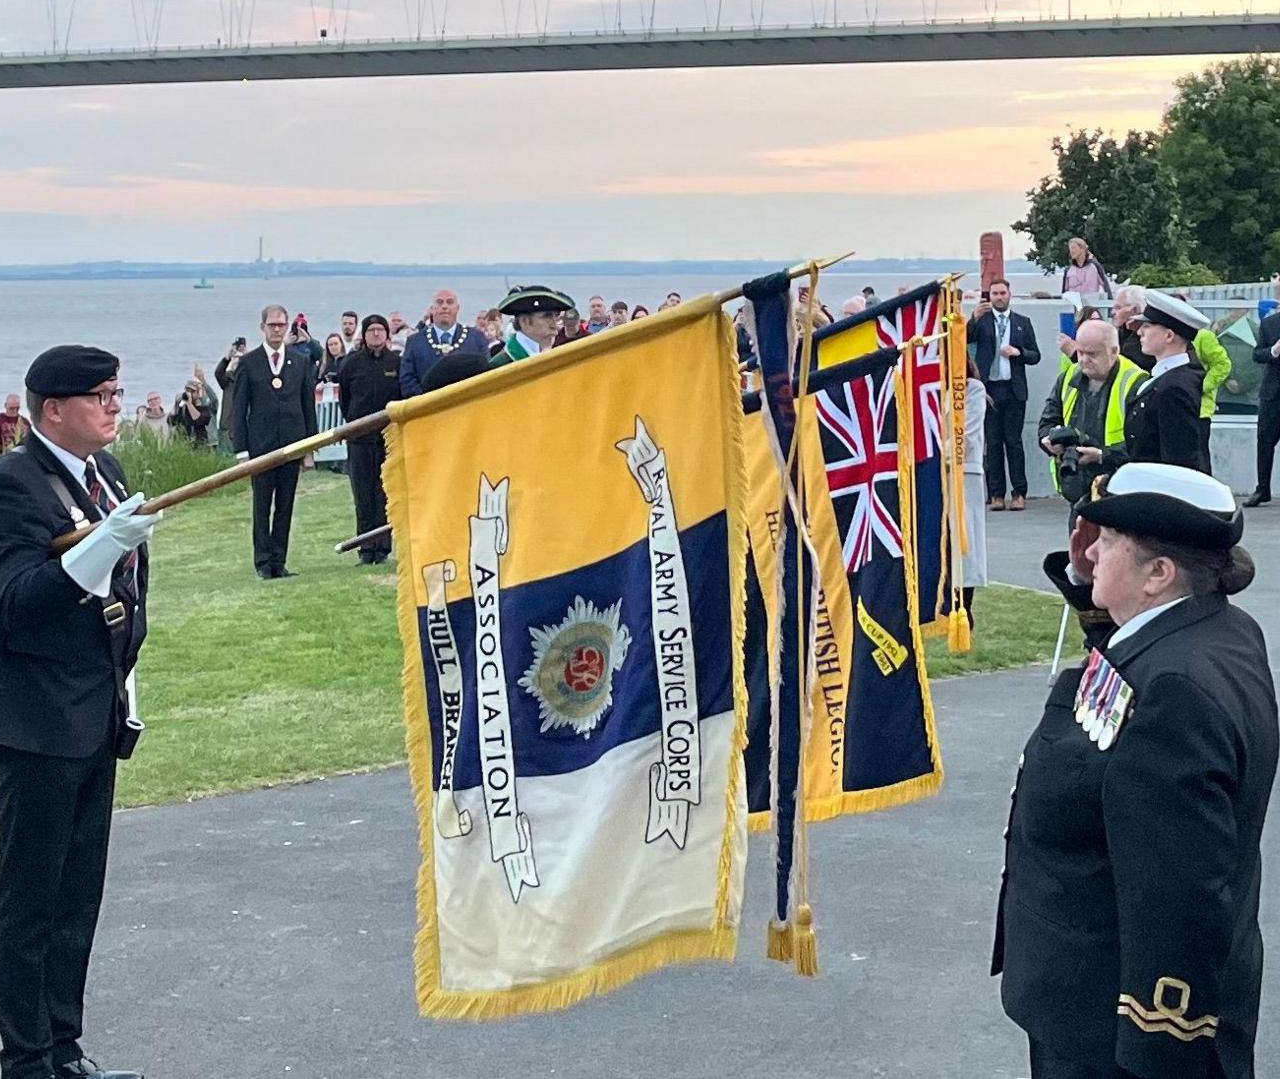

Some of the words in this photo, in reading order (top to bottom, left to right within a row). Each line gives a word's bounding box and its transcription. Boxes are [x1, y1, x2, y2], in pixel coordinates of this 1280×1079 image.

[952, 376, 965, 411] 1933
[653, 549, 678, 616] ARMY
[428, 608, 458, 675] HULL
[866, 623, 884, 640] CUP
[474, 563, 512, 819] ASSOCIATION
[659, 627, 688, 712] SERVICE
[442, 689, 461, 791] BRANCH
[666, 720, 695, 792] CORPS
